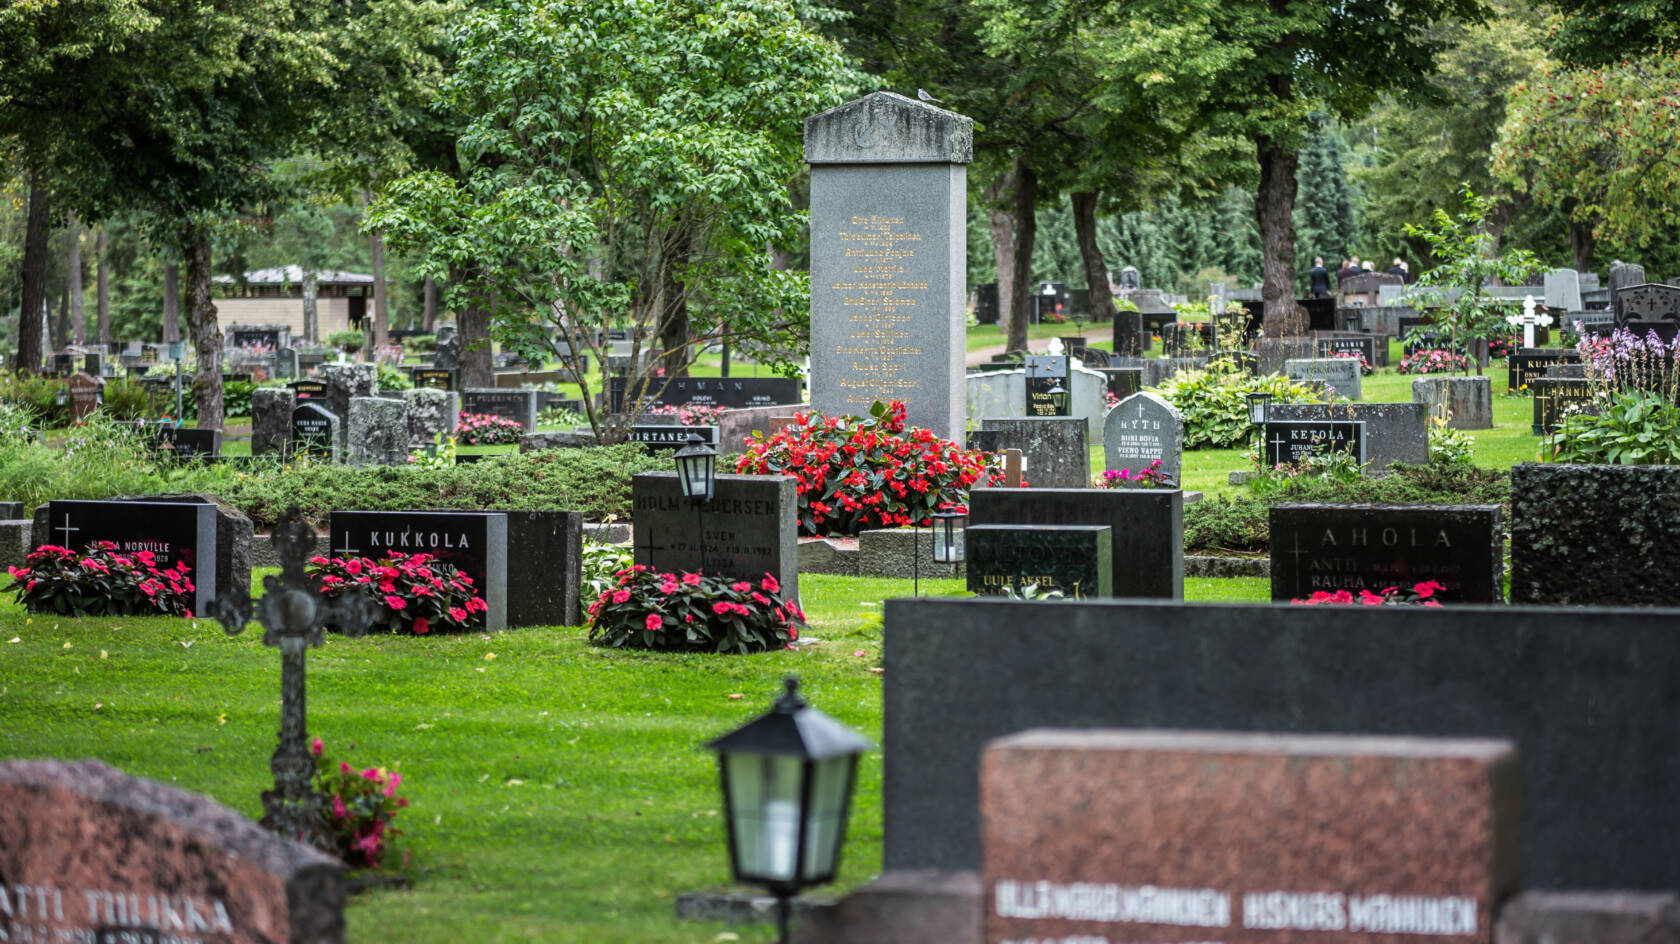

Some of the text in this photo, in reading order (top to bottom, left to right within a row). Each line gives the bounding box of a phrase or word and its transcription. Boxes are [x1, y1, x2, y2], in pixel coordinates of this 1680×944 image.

[1290, 430, 1344, 440] KETOLA
[370, 530, 469, 549] KUKKOLA
[705, 530, 736, 541] SVEN
[1321, 527, 1452, 548] AHOLA
[124, 541, 171, 554] NORVILLE
[1309, 557, 1358, 572] ANTTI
[1311, 575, 1365, 589] RAUHA
